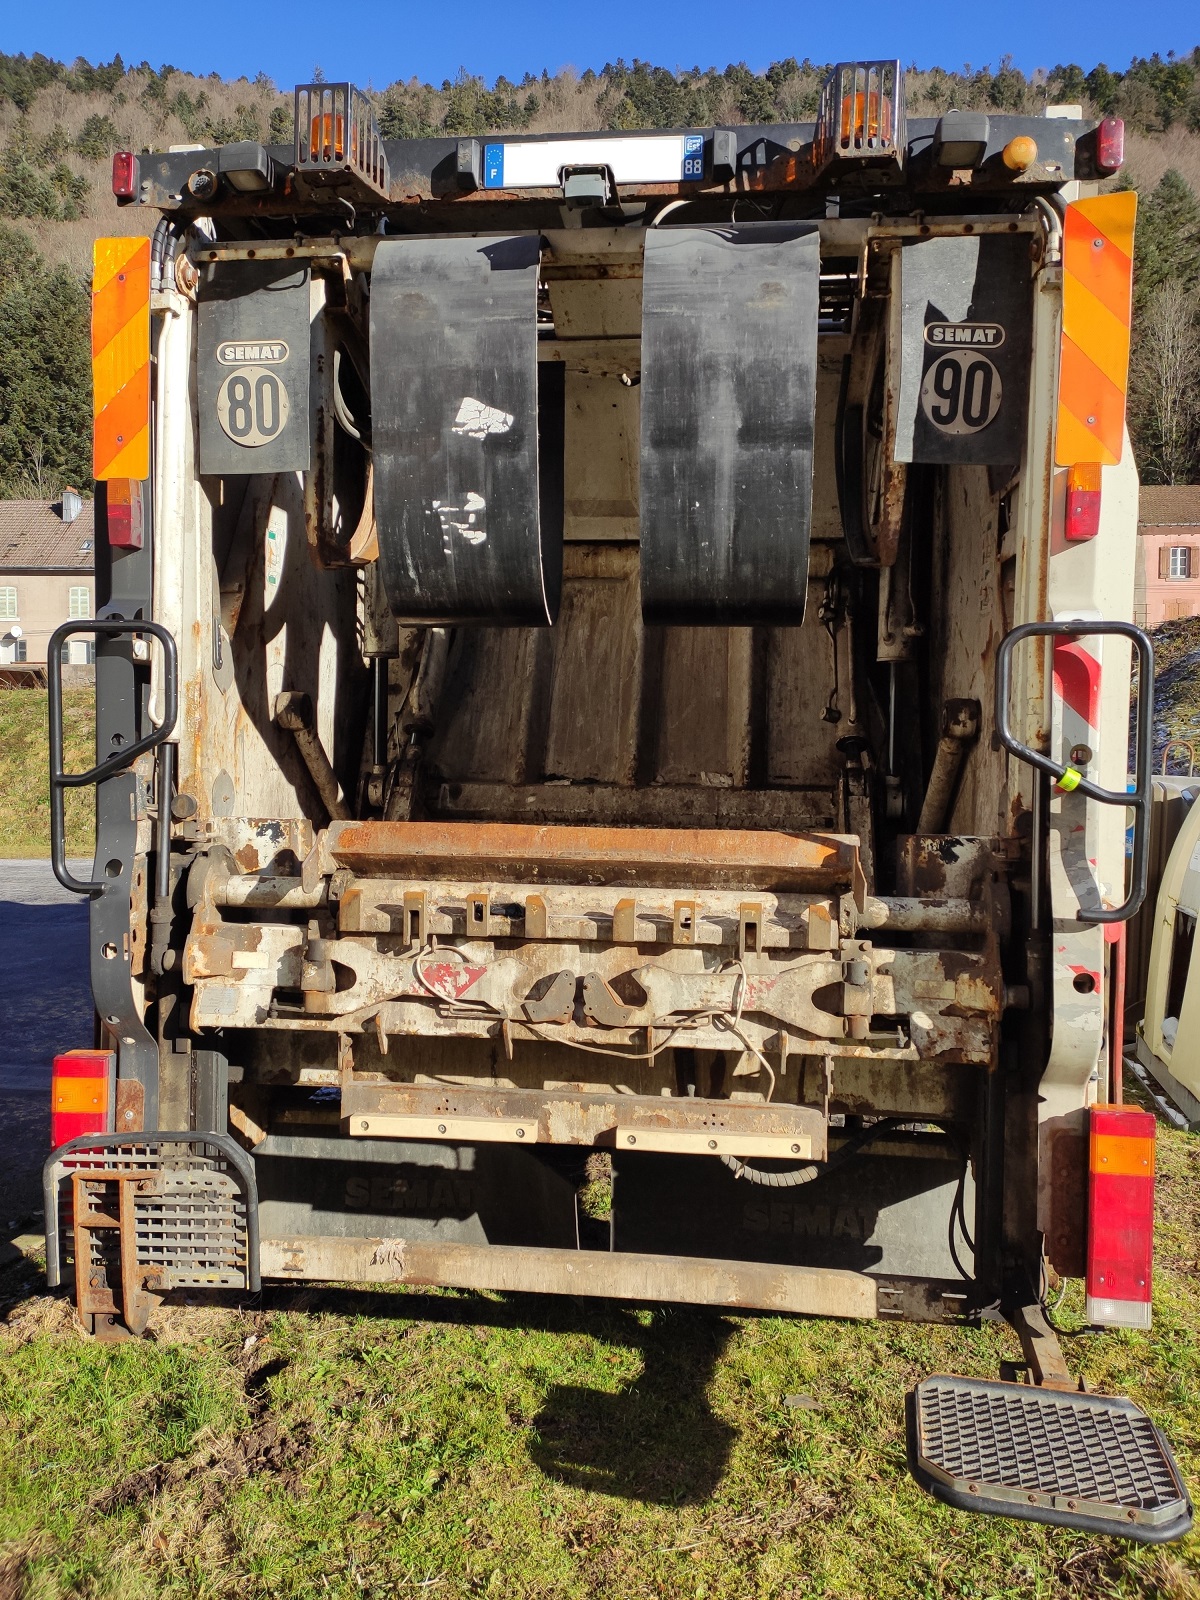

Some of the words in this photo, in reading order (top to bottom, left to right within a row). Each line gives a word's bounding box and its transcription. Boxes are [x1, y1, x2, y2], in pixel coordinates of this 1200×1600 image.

[491, 168, 498, 179] F
[685, 159, 701, 174] 88
[932, 327, 997, 343] SEMAT
[224, 345, 281, 360] SEMAT
[931, 358, 993, 427] 90
[227, 374, 280, 437] 80
[344, 1175, 478, 1209] SEMAT
[742, 1201, 880, 1240] SEMAT
